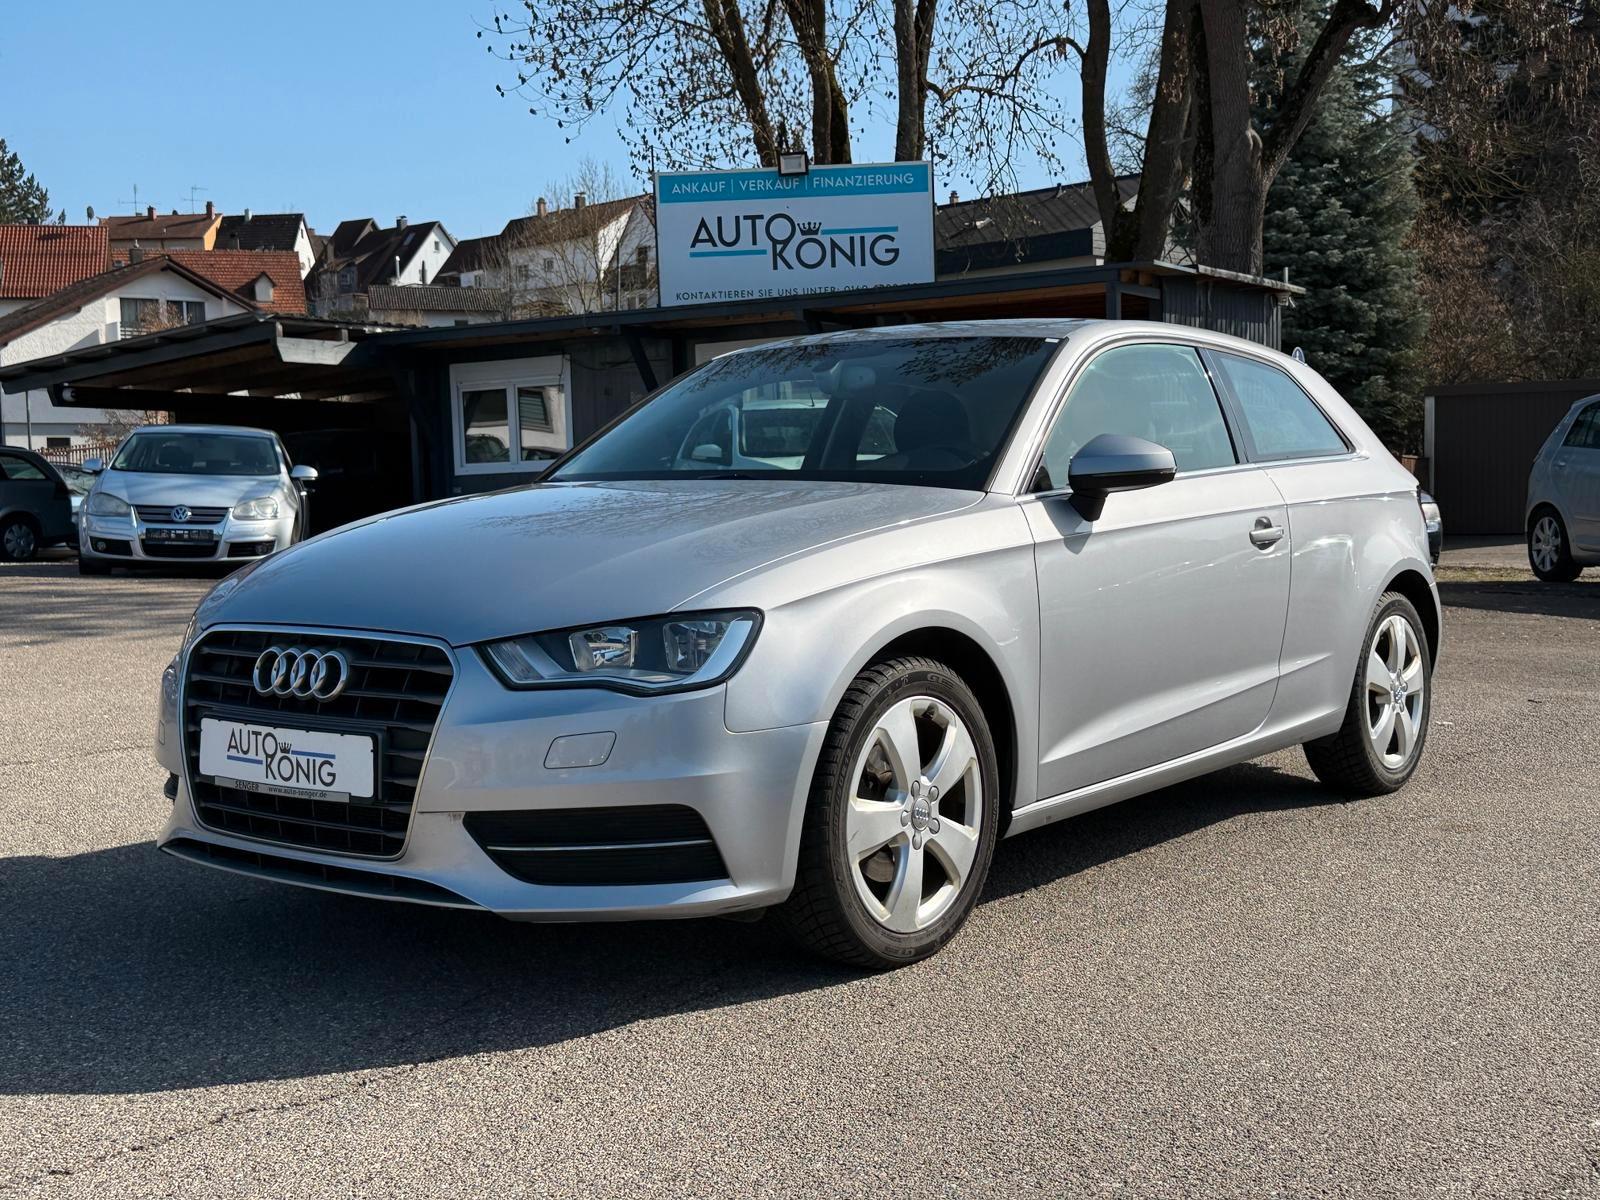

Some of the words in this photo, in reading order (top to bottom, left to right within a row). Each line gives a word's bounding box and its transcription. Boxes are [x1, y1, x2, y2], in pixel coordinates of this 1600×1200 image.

[672, 181, 726, 195] ANKAUF
[739, 177, 800, 192] VERKAUF
[813, 173, 914, 189] FINANZIERUNG
[690, 213, 796, 249] AUTO
[676, 290, 754, 301] KONTAKTIEREN
[758, 288, 773, 298] SIE
[777, 287, 800, 297] UNS
[227, 728, 278, 757] AUTO
[234, 780, 260, 791] SENGER
